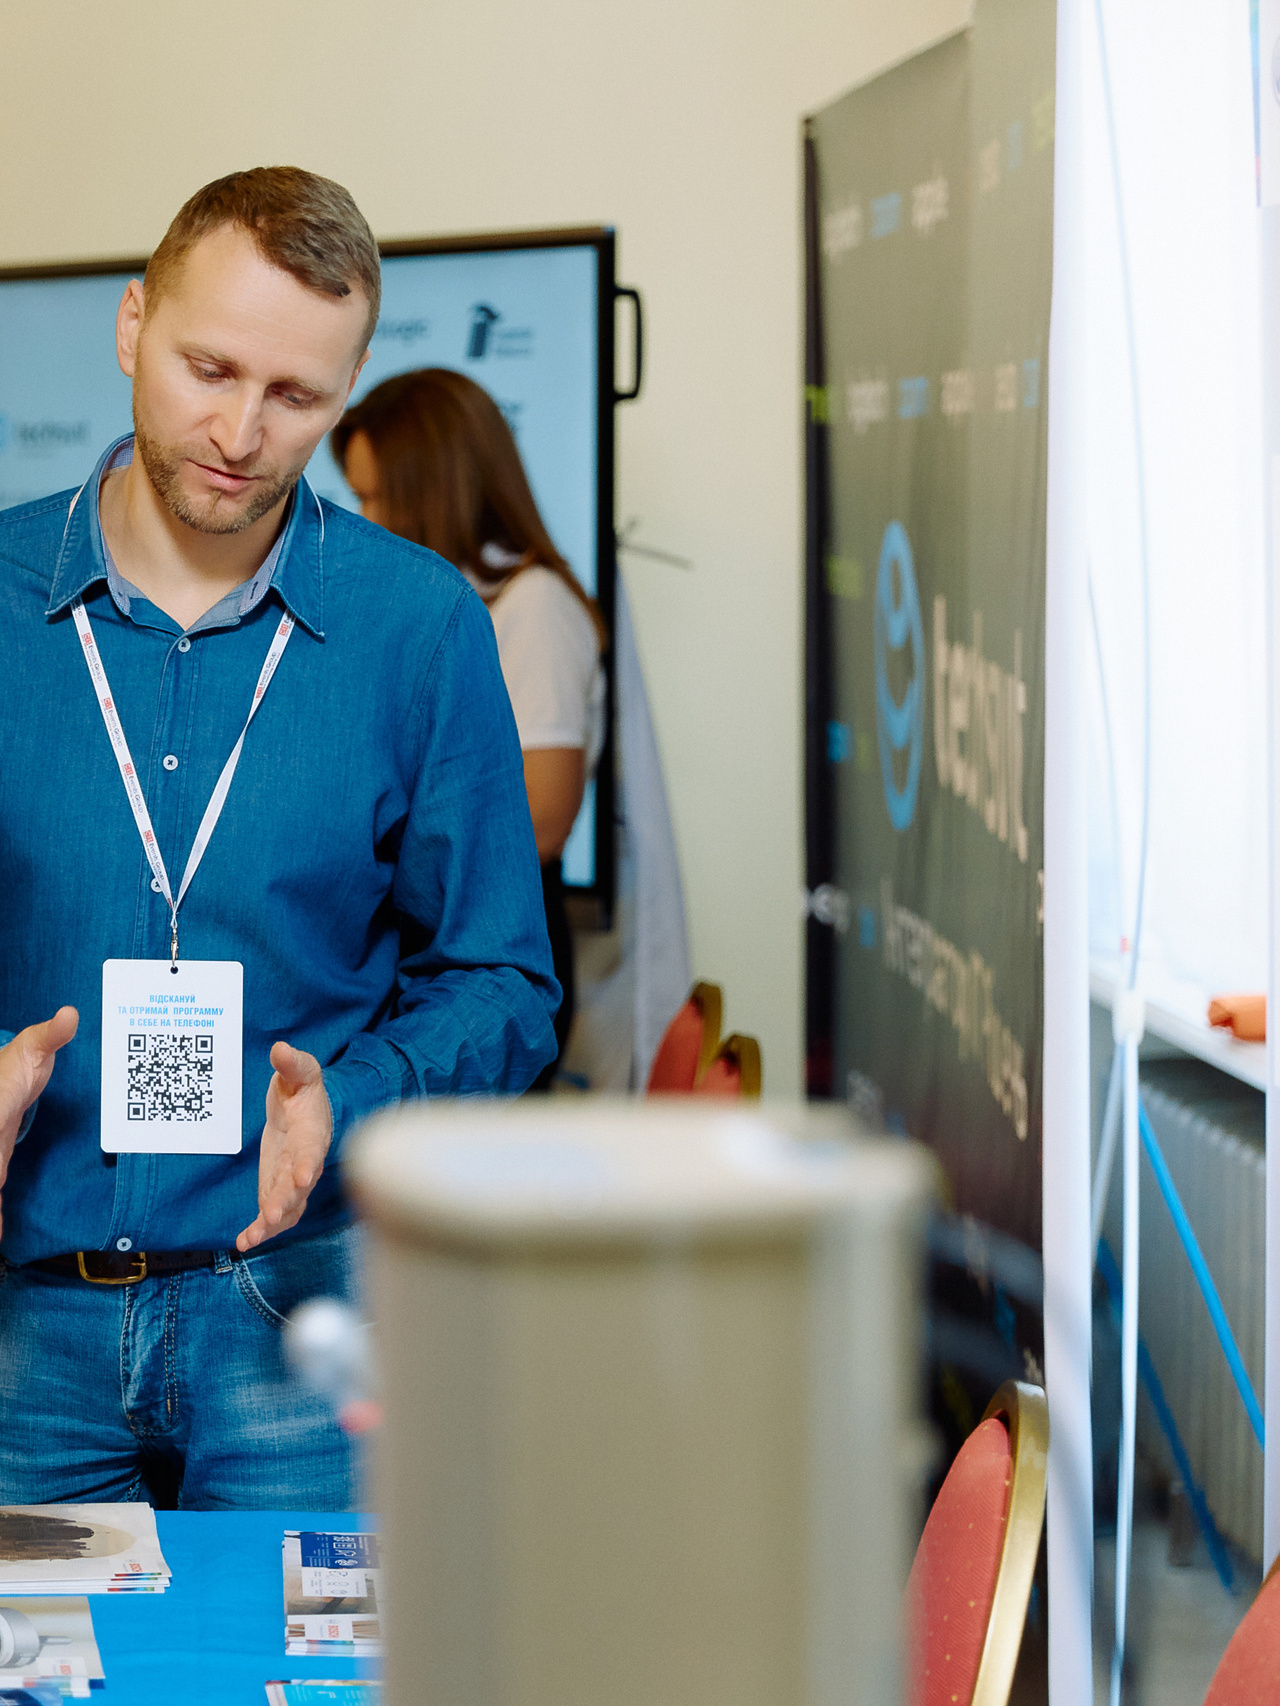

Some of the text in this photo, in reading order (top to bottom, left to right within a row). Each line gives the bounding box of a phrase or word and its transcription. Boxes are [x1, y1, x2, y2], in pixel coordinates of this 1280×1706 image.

[89, 645, 97, 663] Events
[266, 652, 276, 668] Group
[114, 728, 122, 746] Group
[129, 776, 138, 793] Events
[135, 794, 143, 813] Group
[156, 862, 164, 880] Group
[149, 994, 196, 1004] ВІДСКАНУЙ
[117, 1005, 224, 1016] ТА ОТРИМАЙ ПРОГРАММУ
[129, 1018, 214, 1028] В СЕБЕ НА ТЕЛЕФОНІ
